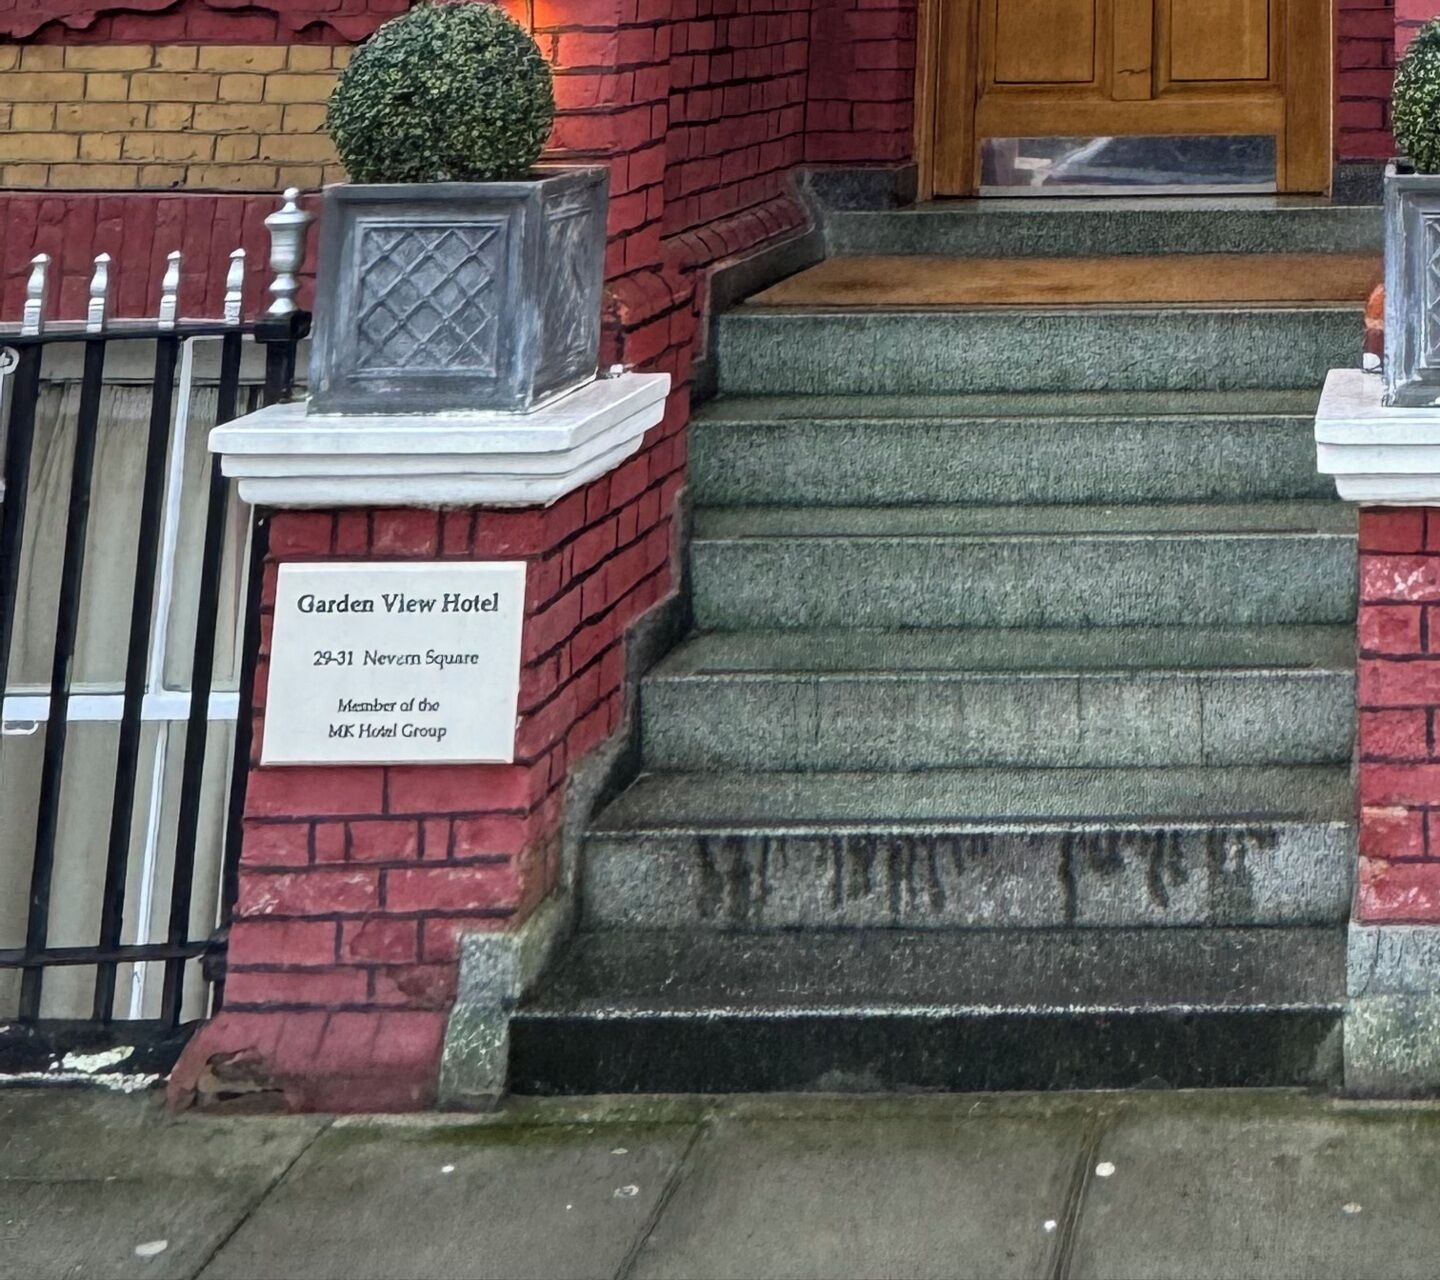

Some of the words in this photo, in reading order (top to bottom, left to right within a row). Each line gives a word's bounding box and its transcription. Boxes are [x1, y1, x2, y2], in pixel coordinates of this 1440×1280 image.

[297, 594, 374, 613] Garden
[382, 594, 435, 613] View
[442, 593, 499, 613] Hotel
[313, 650, 353, 666] 29-31
[363, 650, 421, 666] Nevern
[426, 650, 479, 670] Square
[338, 698, 396, 713] Member
[400, 698, 414, 712] of
[418, 698, 440, 712] the
[328, 724, 354, 738] MK
[358, 724, 397, 738] Hotel
[402, 724, 447, 741] Group
